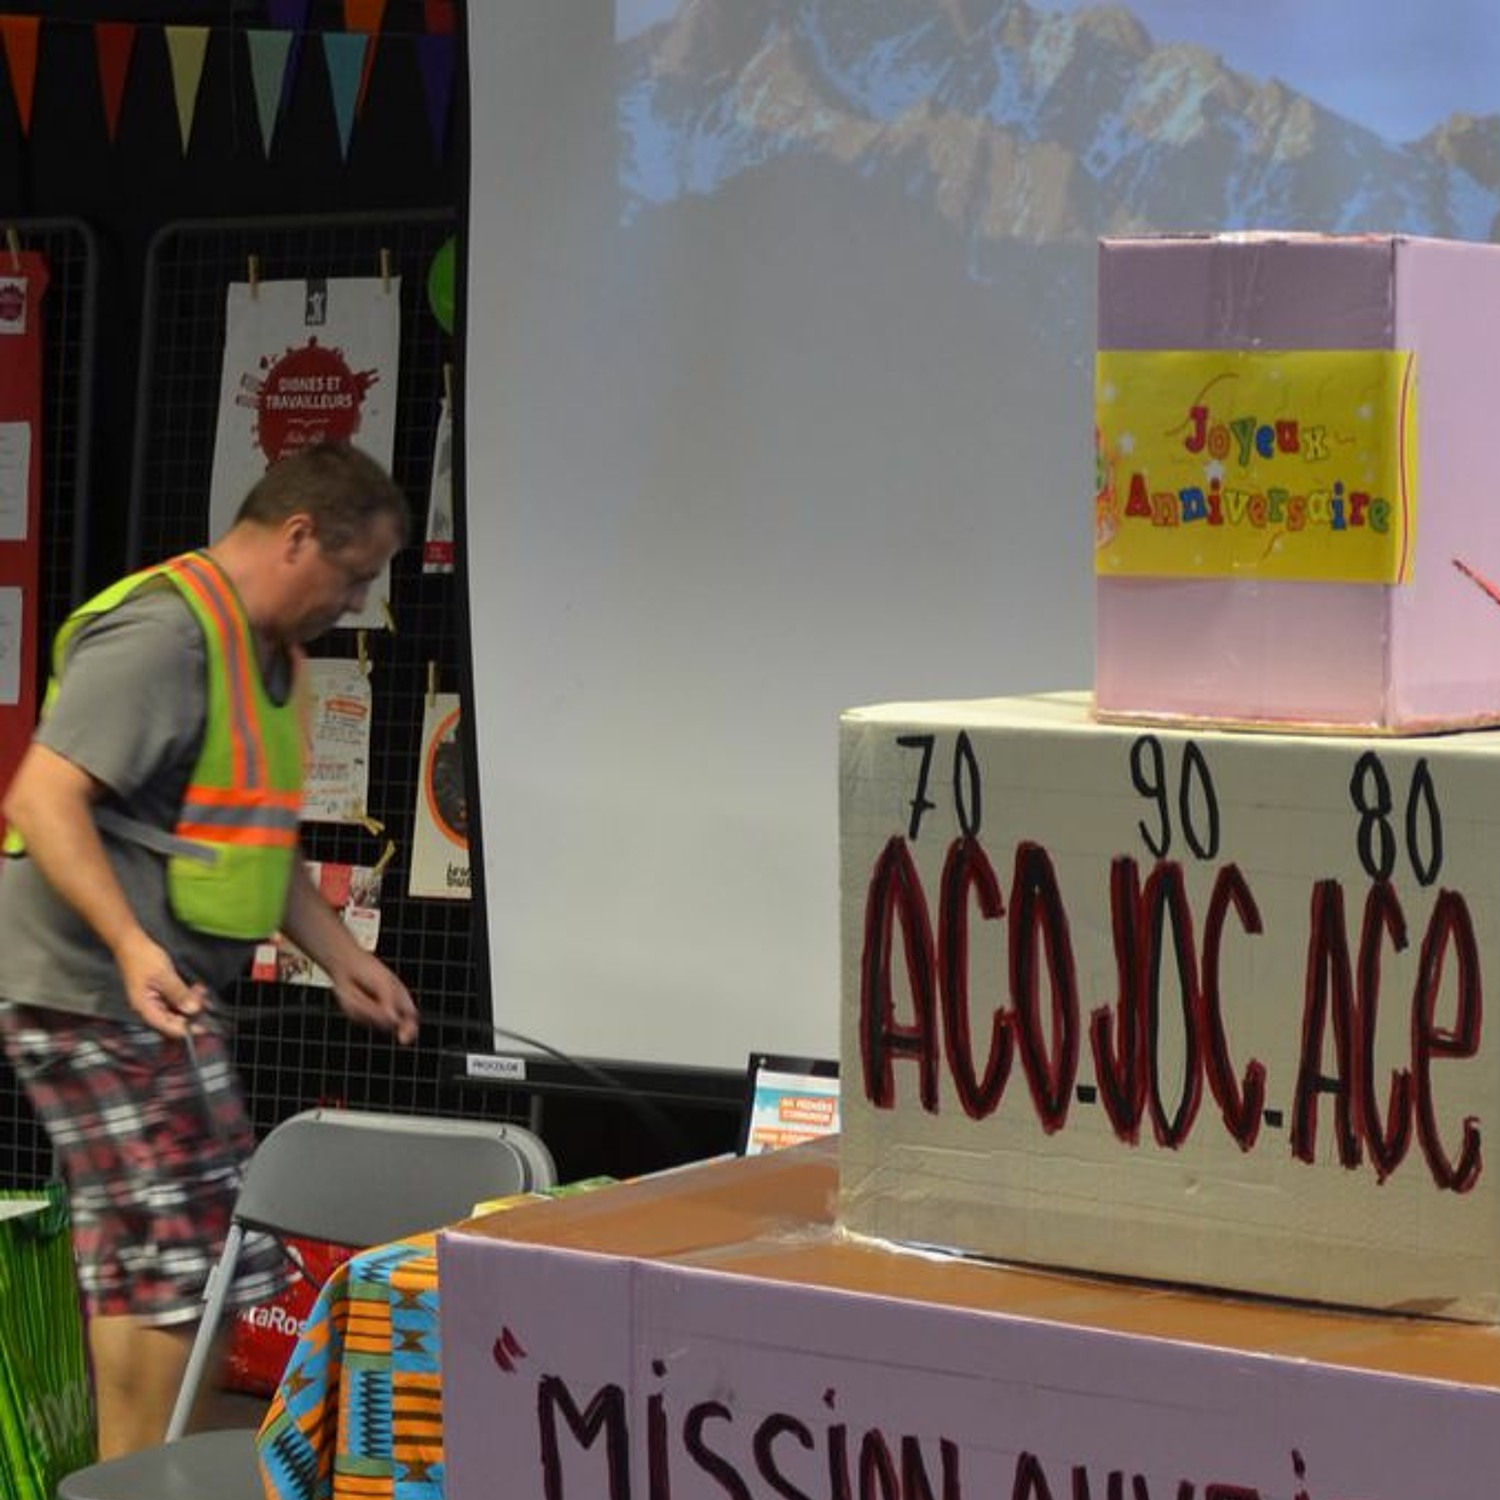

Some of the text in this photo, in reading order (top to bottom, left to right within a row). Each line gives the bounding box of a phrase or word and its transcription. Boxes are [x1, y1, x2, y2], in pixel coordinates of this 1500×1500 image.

[265, 393, 353, 410] TRAVAILLEURS
[1184, 405, 1330, 467] Joyeux
[1125, 472, 1391, 534] Anniversaire
[896, 730, 982, 841] 70
[1129, 734, 1220, 860] 90
[1349, 750, 1444, 887] 80
